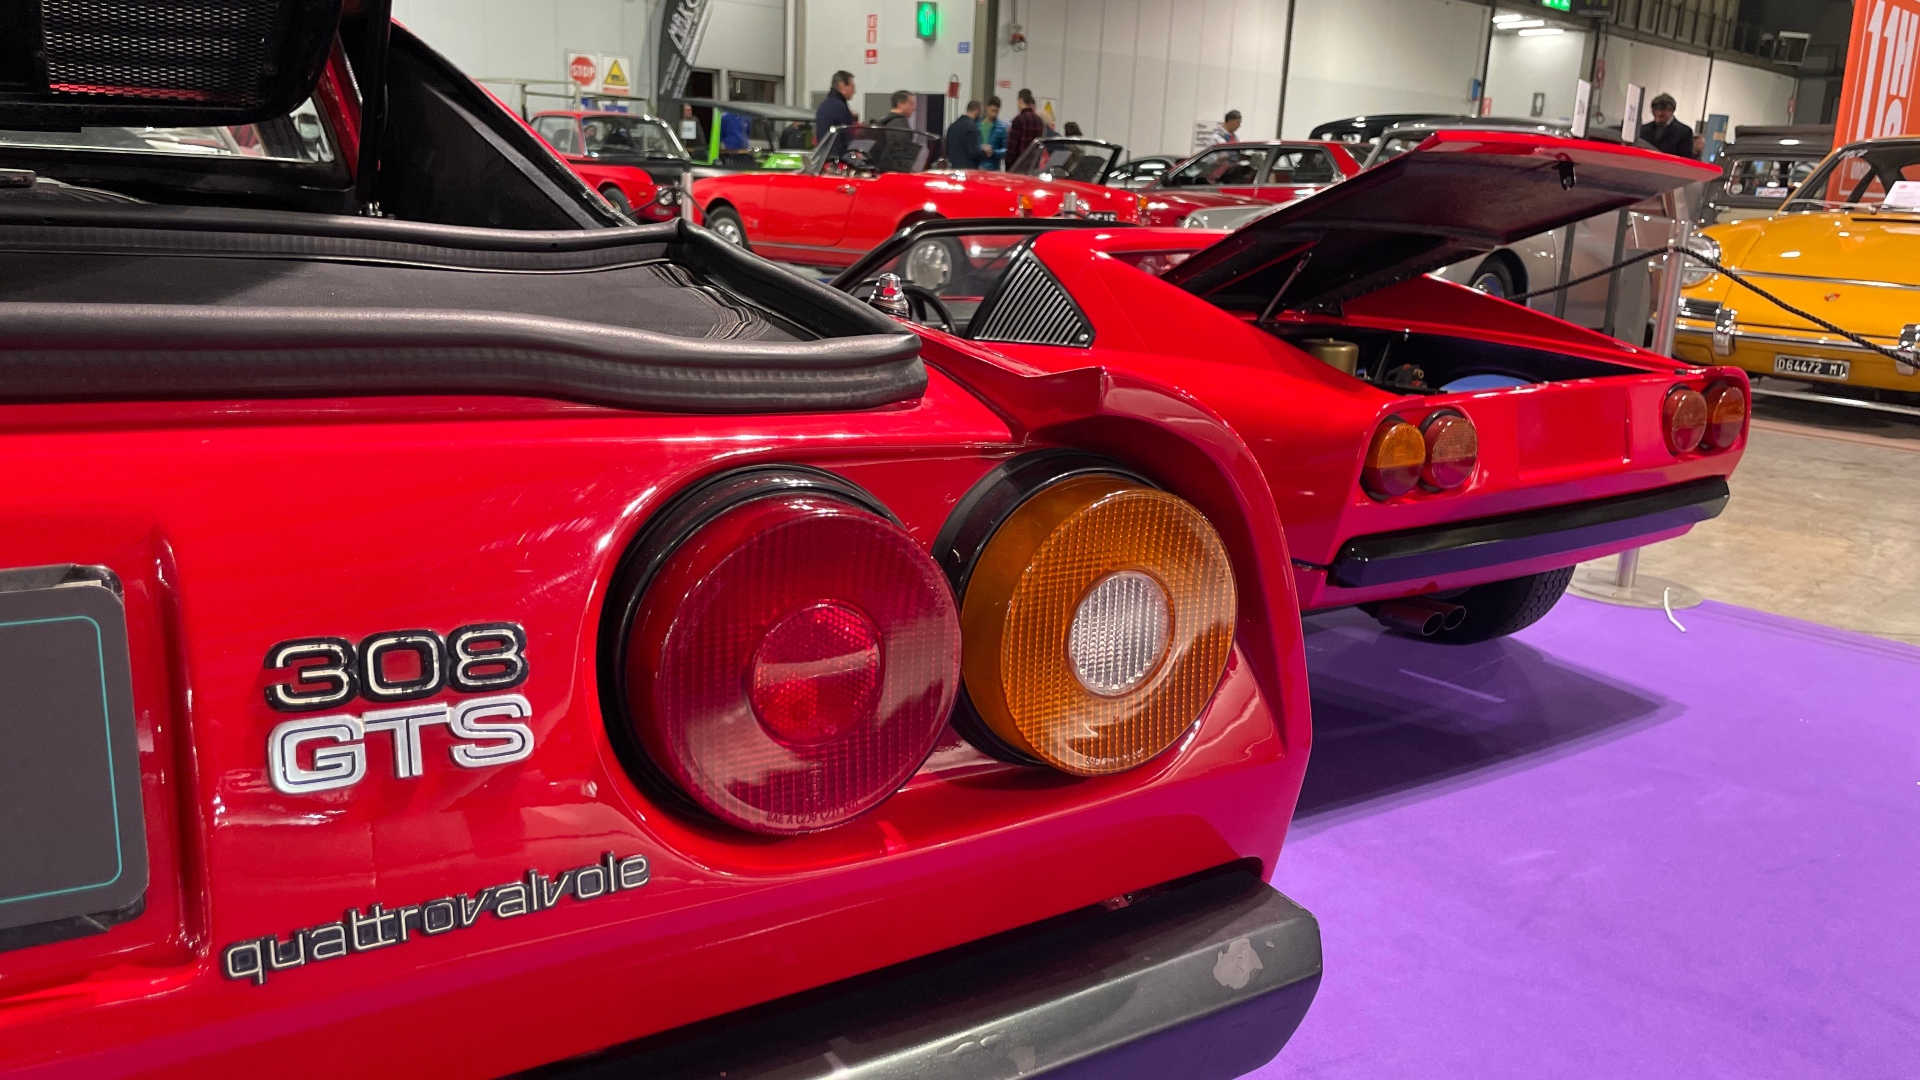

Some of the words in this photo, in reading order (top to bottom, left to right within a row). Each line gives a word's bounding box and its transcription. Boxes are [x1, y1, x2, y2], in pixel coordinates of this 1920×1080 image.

[571, 64, 596, 78] STOP
[1777, 358, 1822, 375] D64472
[263, 621, 530, 712] 308
[267, 694, 535, 796] GTS
[221, 850, 652, 985] quattrovalvole
